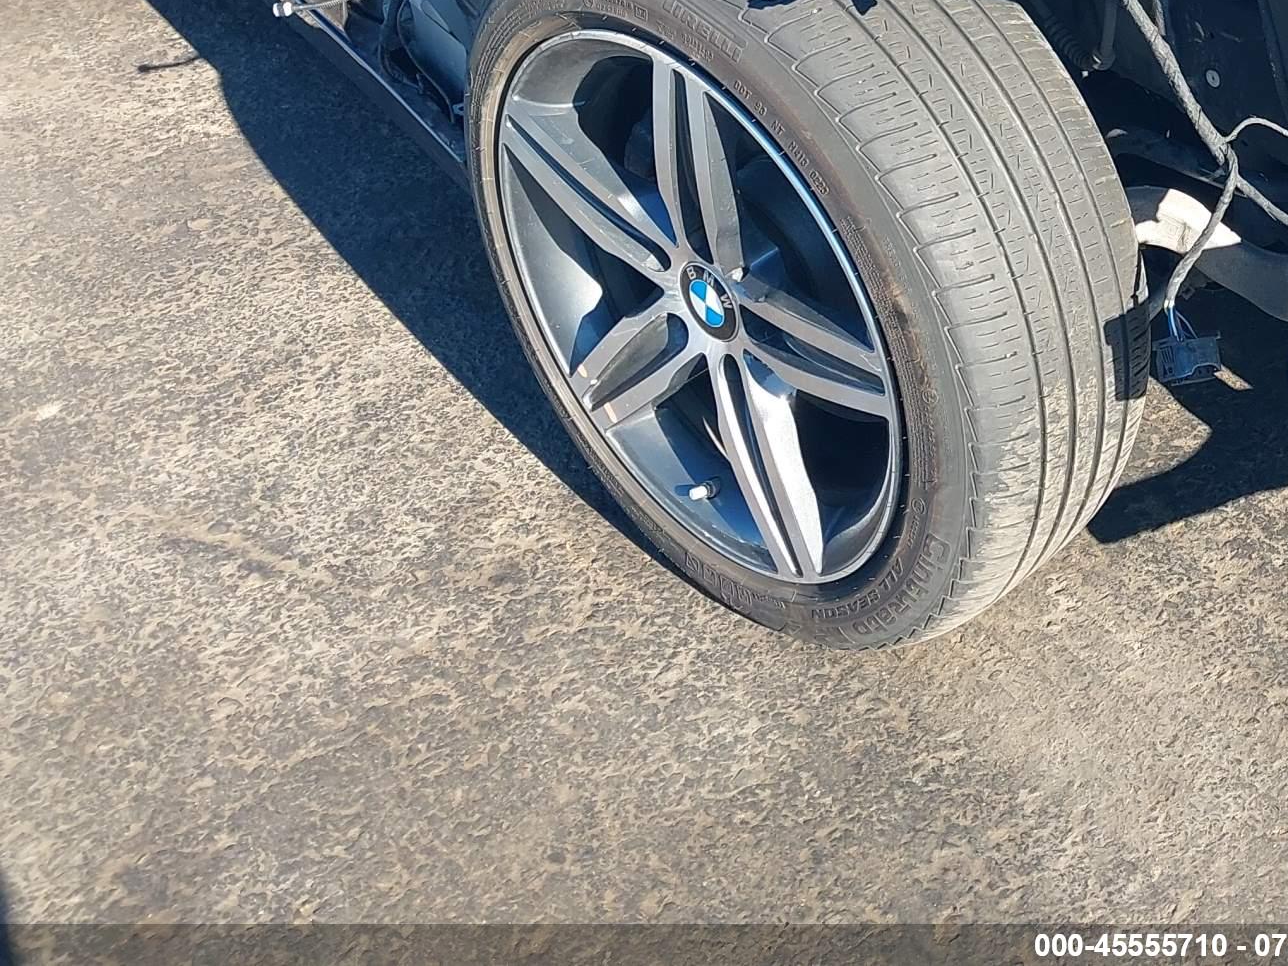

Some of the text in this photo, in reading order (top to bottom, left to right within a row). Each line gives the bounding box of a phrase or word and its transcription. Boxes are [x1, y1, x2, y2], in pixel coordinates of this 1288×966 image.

[734, 80, 753, 100] DOT
[686, 266, 733, 309] BMW
[811, 556, 904, 619] ALL SEASON
